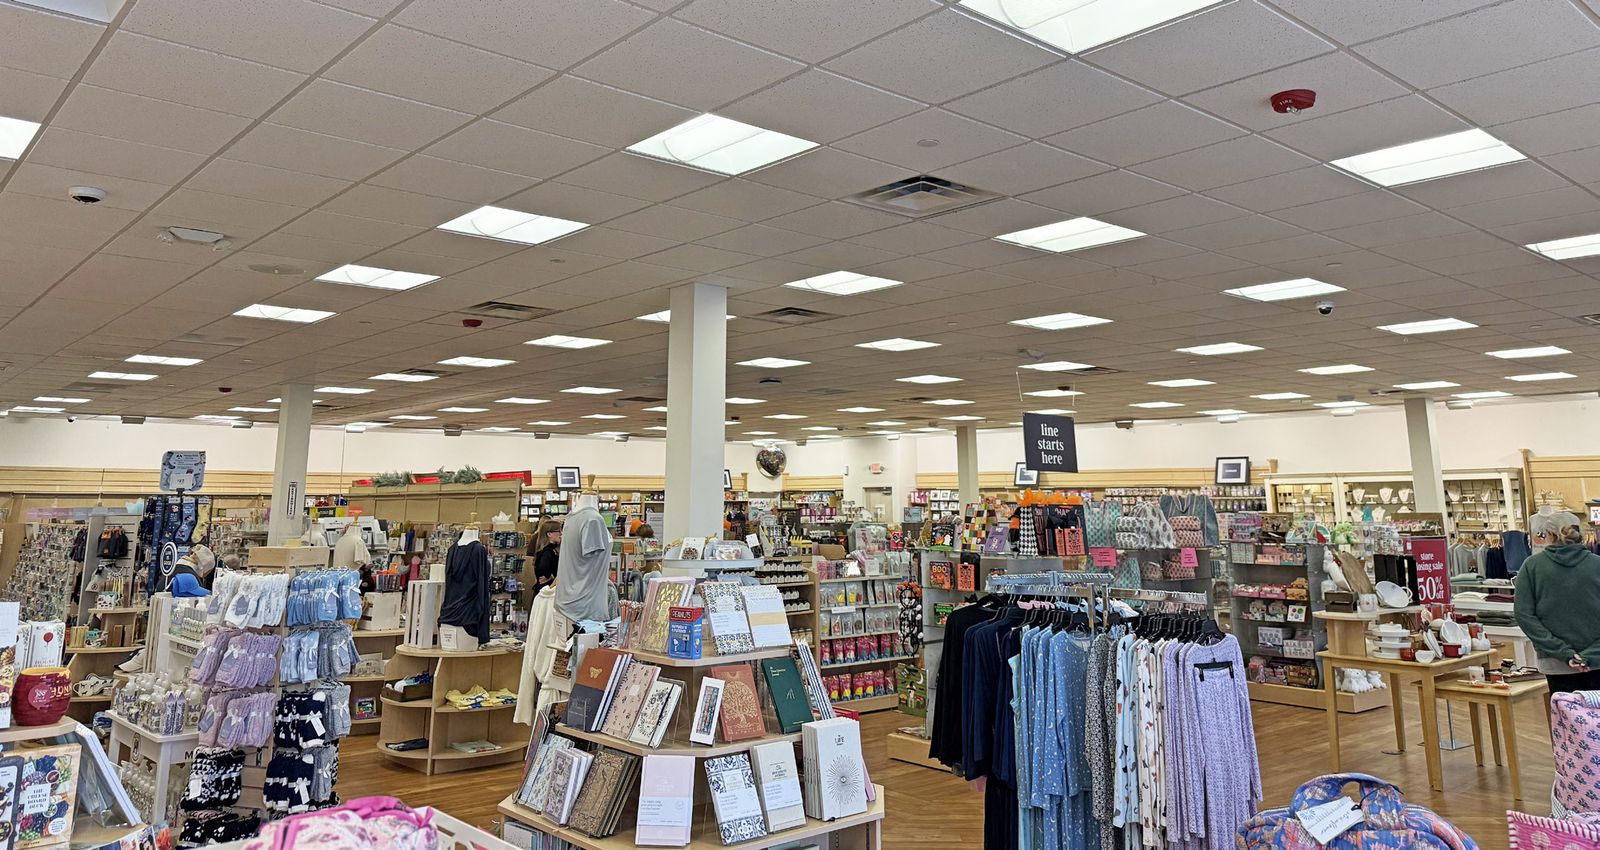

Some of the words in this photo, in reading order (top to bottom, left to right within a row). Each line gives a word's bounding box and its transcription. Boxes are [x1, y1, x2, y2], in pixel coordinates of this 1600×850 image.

[1040, 423, 1059, 437] line
[1037, 439, 1064, 451] starts
[1041, 451, 1063, 465] here
[1416, 562, 1433, 573] losing
[1432, 561, 1443, 570] sale
[1417, 576, 1444, 601] 50%
[1436, 590, 1444, 599] off
[672, 611, 692, 619] PEANUTS
